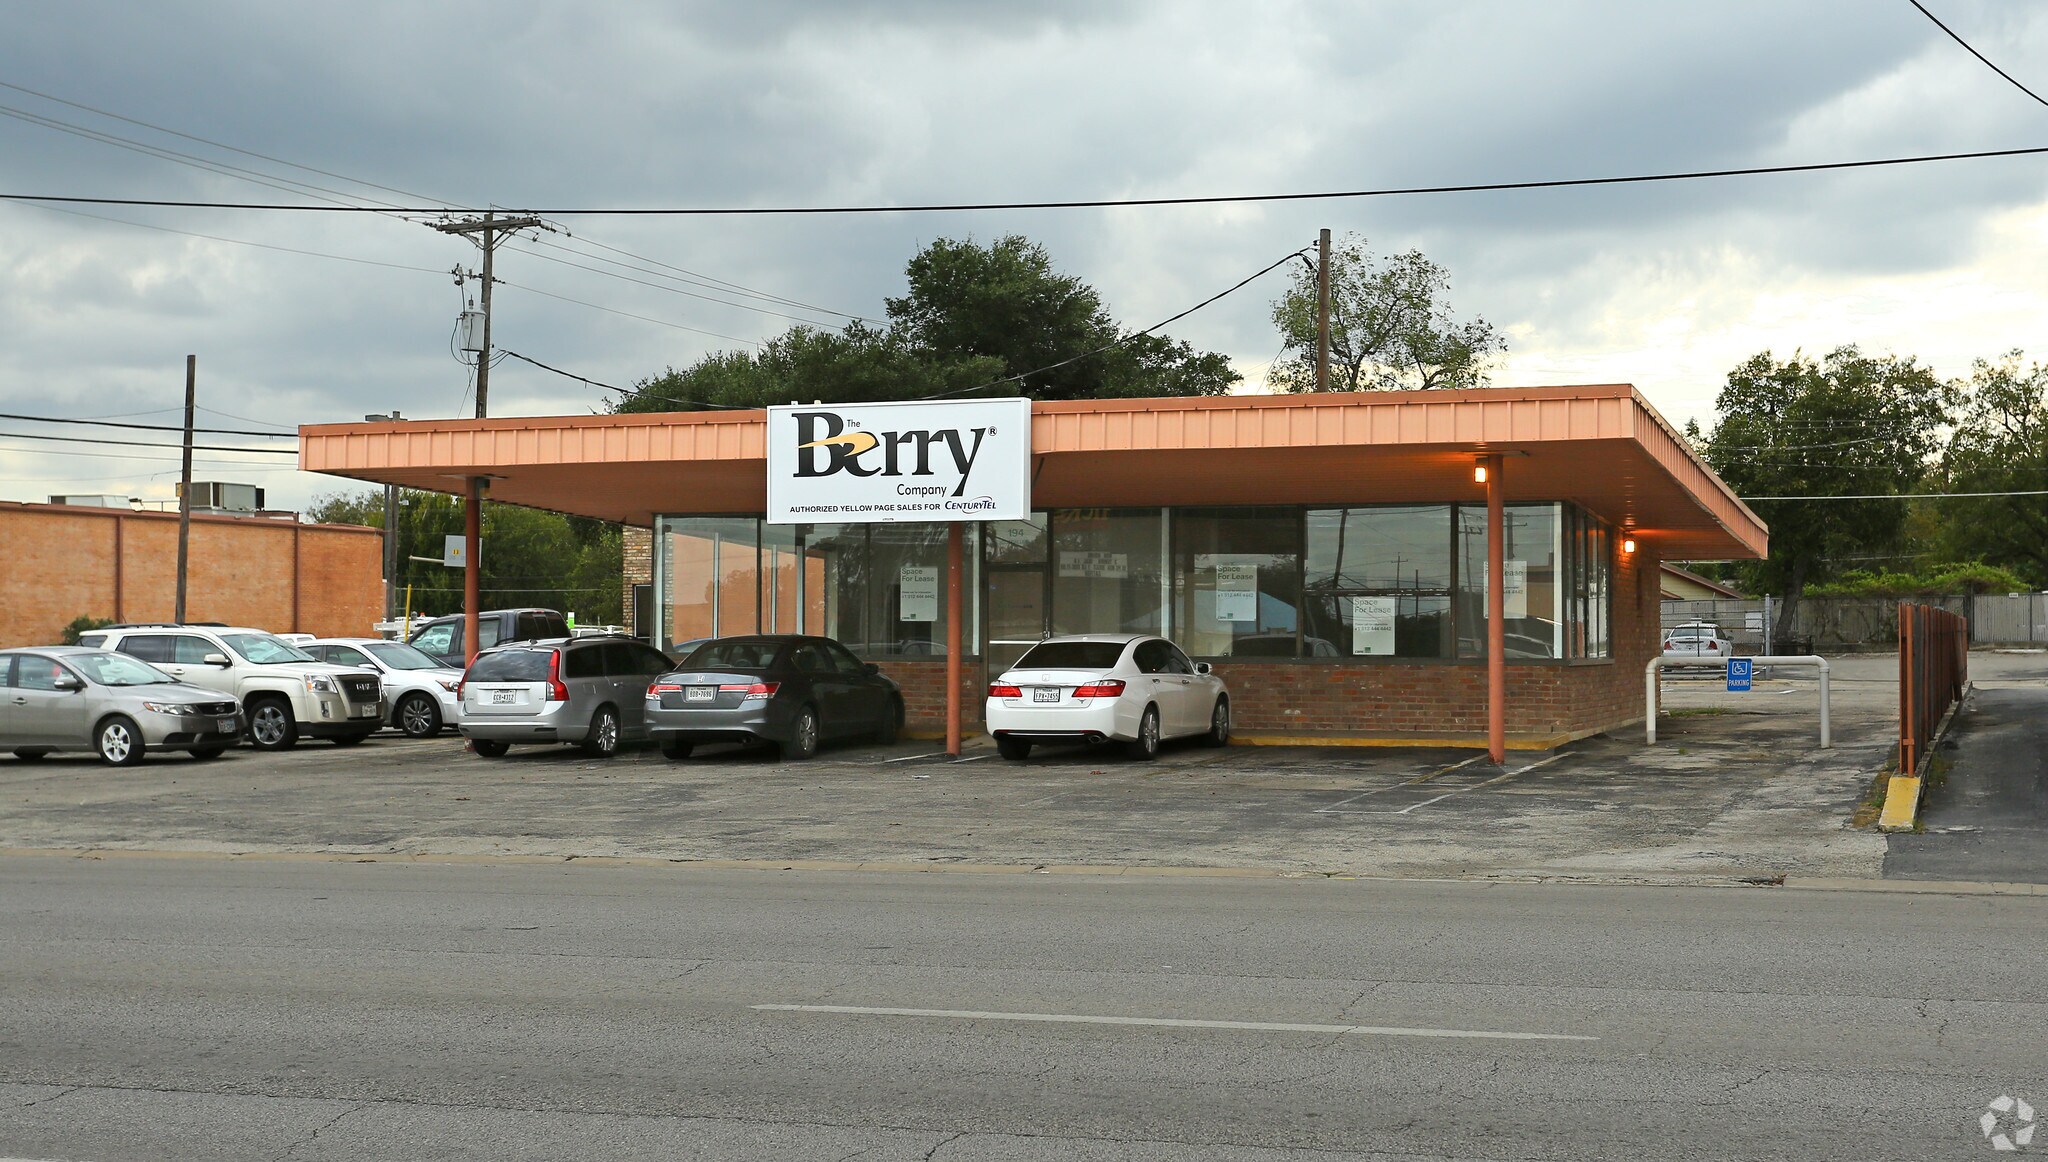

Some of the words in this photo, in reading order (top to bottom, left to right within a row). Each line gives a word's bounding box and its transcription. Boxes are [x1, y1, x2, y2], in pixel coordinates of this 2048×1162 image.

[847, 419, 861, 428] The
[791, 412, 986, 497] Berry
[896, 484, 947, 498] Company
[789, 505, 839, 513] AUTHORIZED
[840, 504, 873, 512] YELLOW
[1007, 528, 1024, 537] 194
[1728, 679, 1750, 687] PARKING
